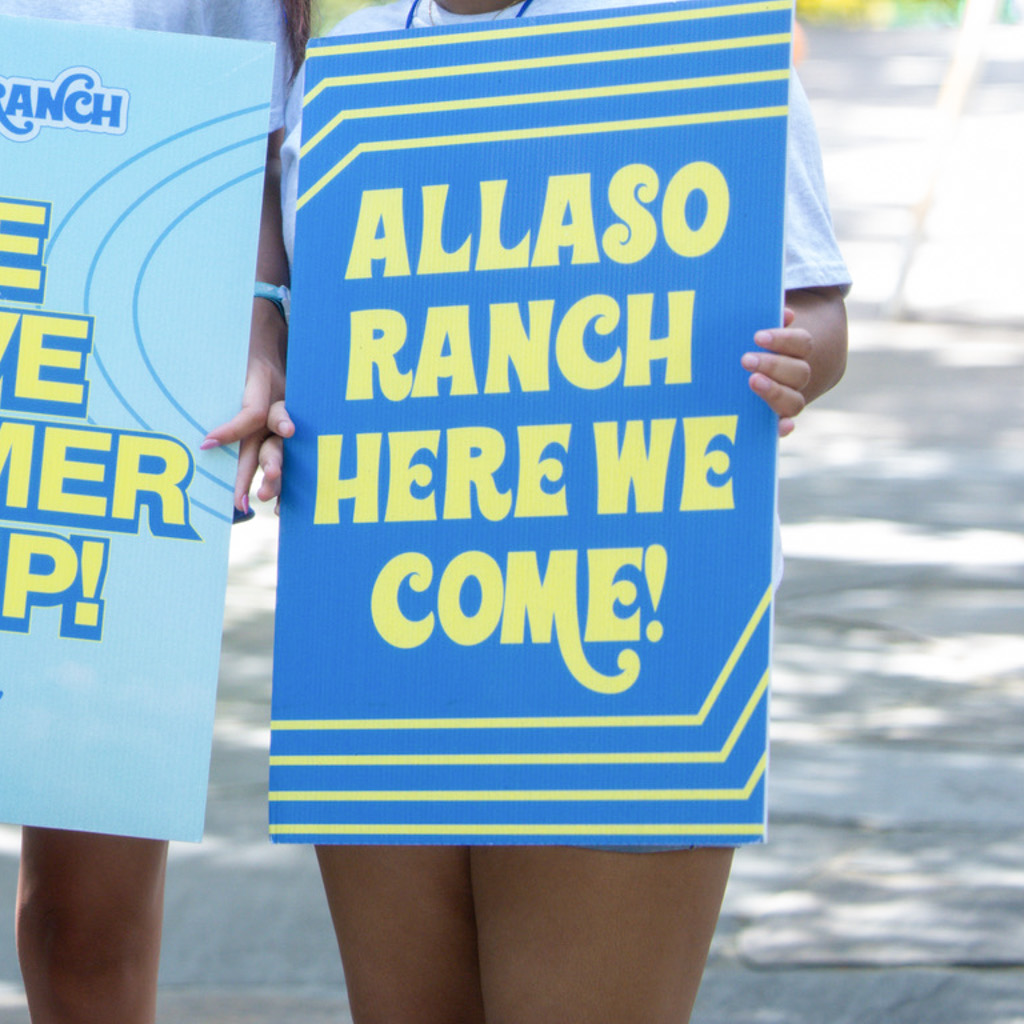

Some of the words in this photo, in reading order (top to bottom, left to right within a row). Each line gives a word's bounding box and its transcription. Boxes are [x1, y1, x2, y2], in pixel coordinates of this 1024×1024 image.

[344, 160, 730, 280] ALLASO
[344, 290, 696, 402] RANCH
[313, 423, 572, 525] HERE
[592, 414, 739, 516] WE
[371, 544, 668, 694] COME!
